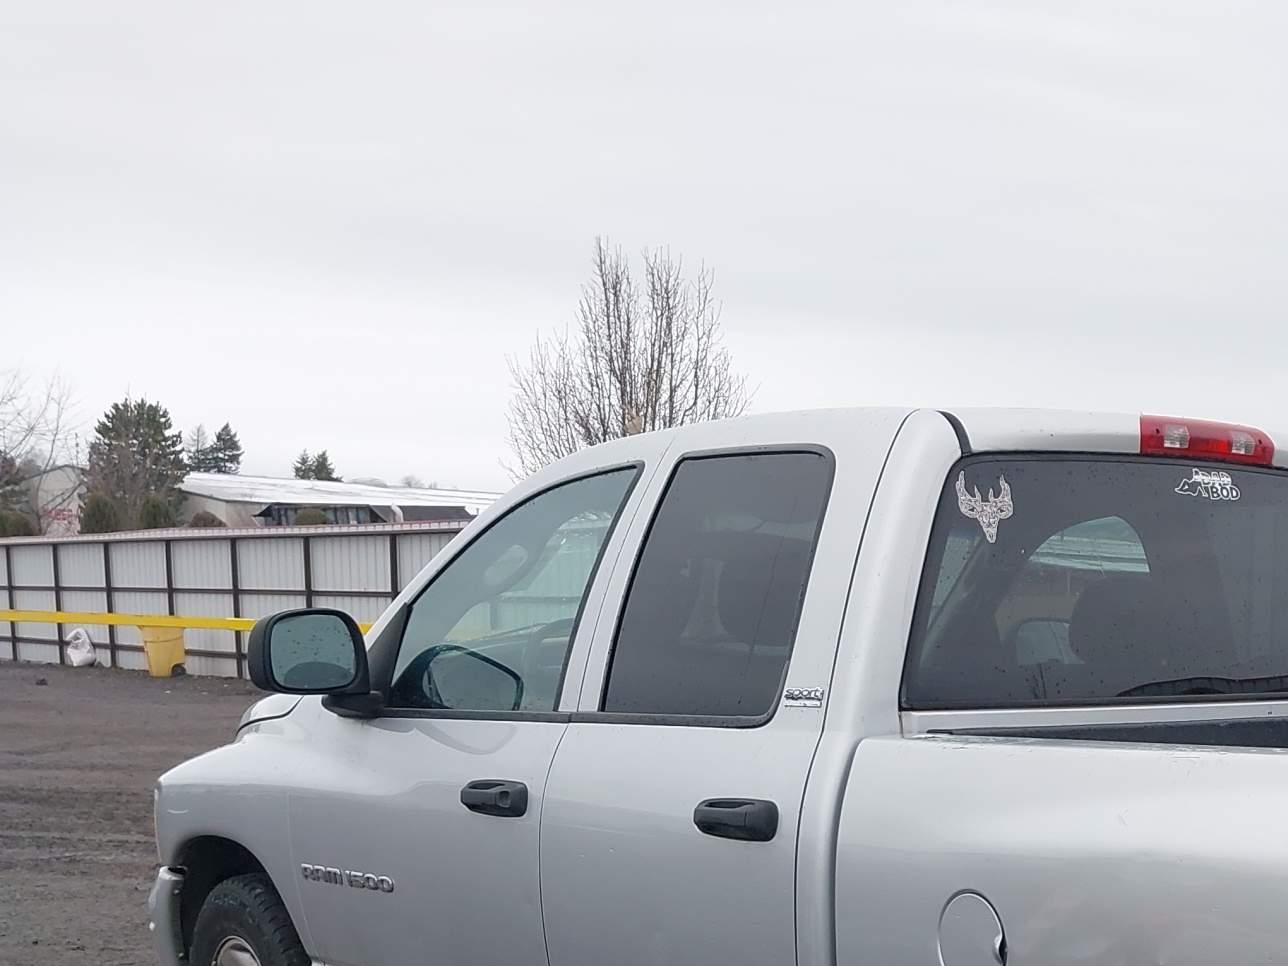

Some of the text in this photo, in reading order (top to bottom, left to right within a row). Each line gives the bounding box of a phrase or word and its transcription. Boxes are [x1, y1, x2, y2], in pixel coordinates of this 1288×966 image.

[1210, 485, 1241, 501] BOD
[301, 863, 394, 893] RAM 1500
